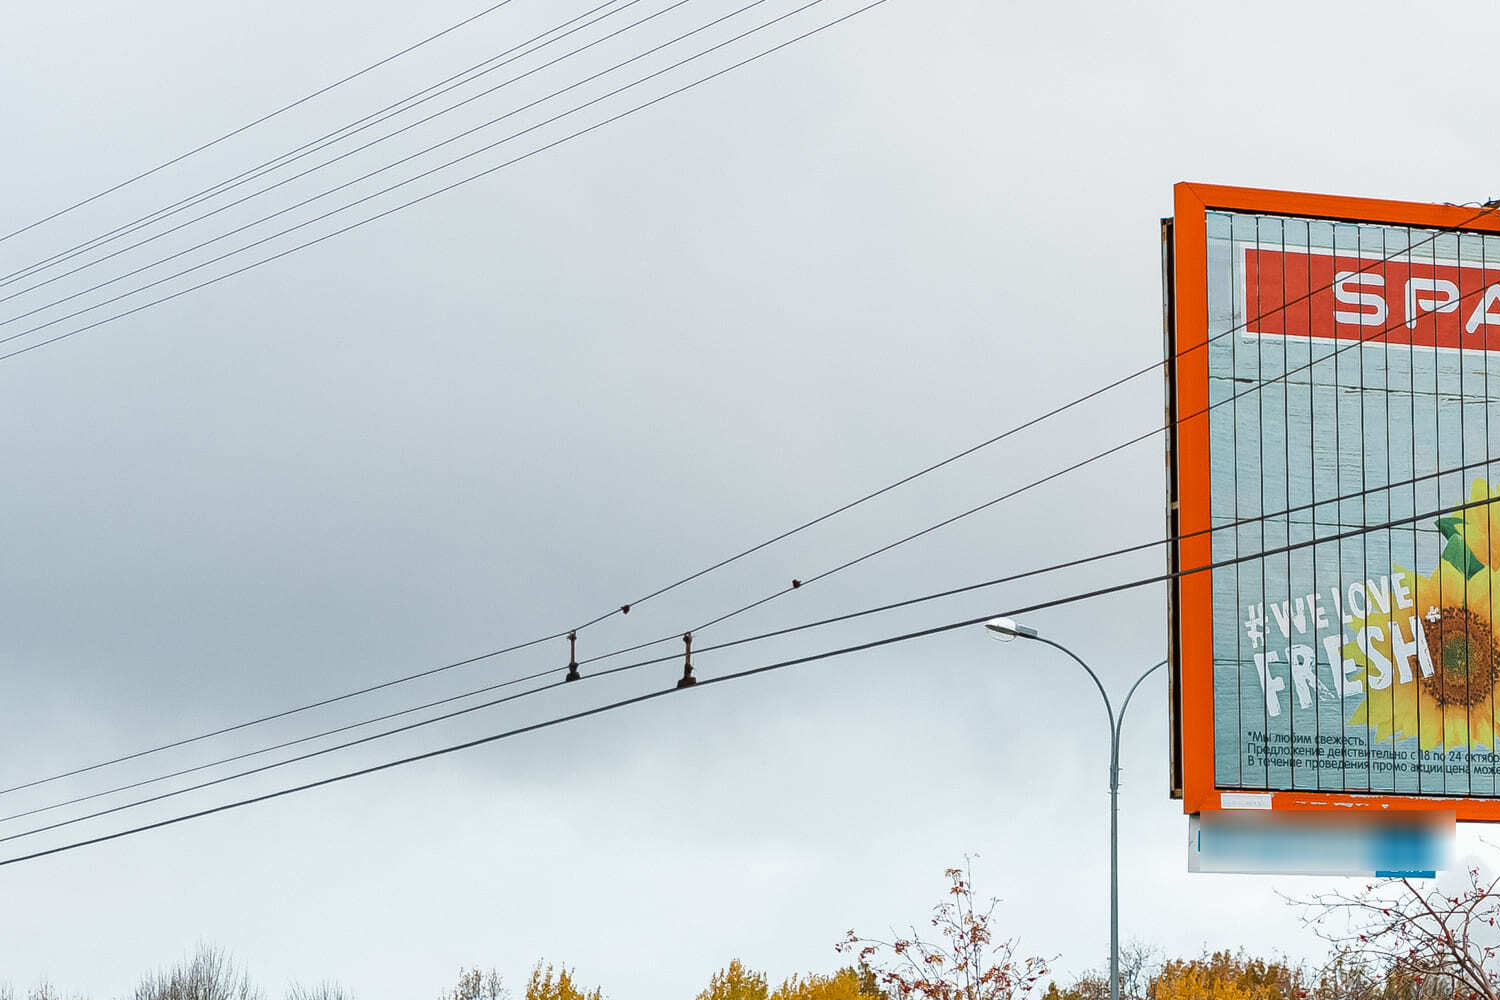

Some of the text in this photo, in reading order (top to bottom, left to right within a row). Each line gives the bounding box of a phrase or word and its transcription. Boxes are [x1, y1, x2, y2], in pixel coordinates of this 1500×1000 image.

[1331, 572, 1414, 625] LOVE
[1273, 733, 1312, 745] любим
[1249, 743, 1325, 759] Предложение
[1327, 746, 1408, 762] действительно
[1411, 752, 1416, 760] с
[1420, 751, 1430, 761] 18
[1433, 753, 1445, 762] по
[1449, 751, 1462, 762] 24
[1248, 756, 1254, 765] В
[1256, 757, 1303, 768] течение
[1305, 758, 1369, 771] проведения
[1372, 761, 1408, 772] промо
[1410, 762, 1443, 774] акции
[1446, 764, 1470, 776] цена
